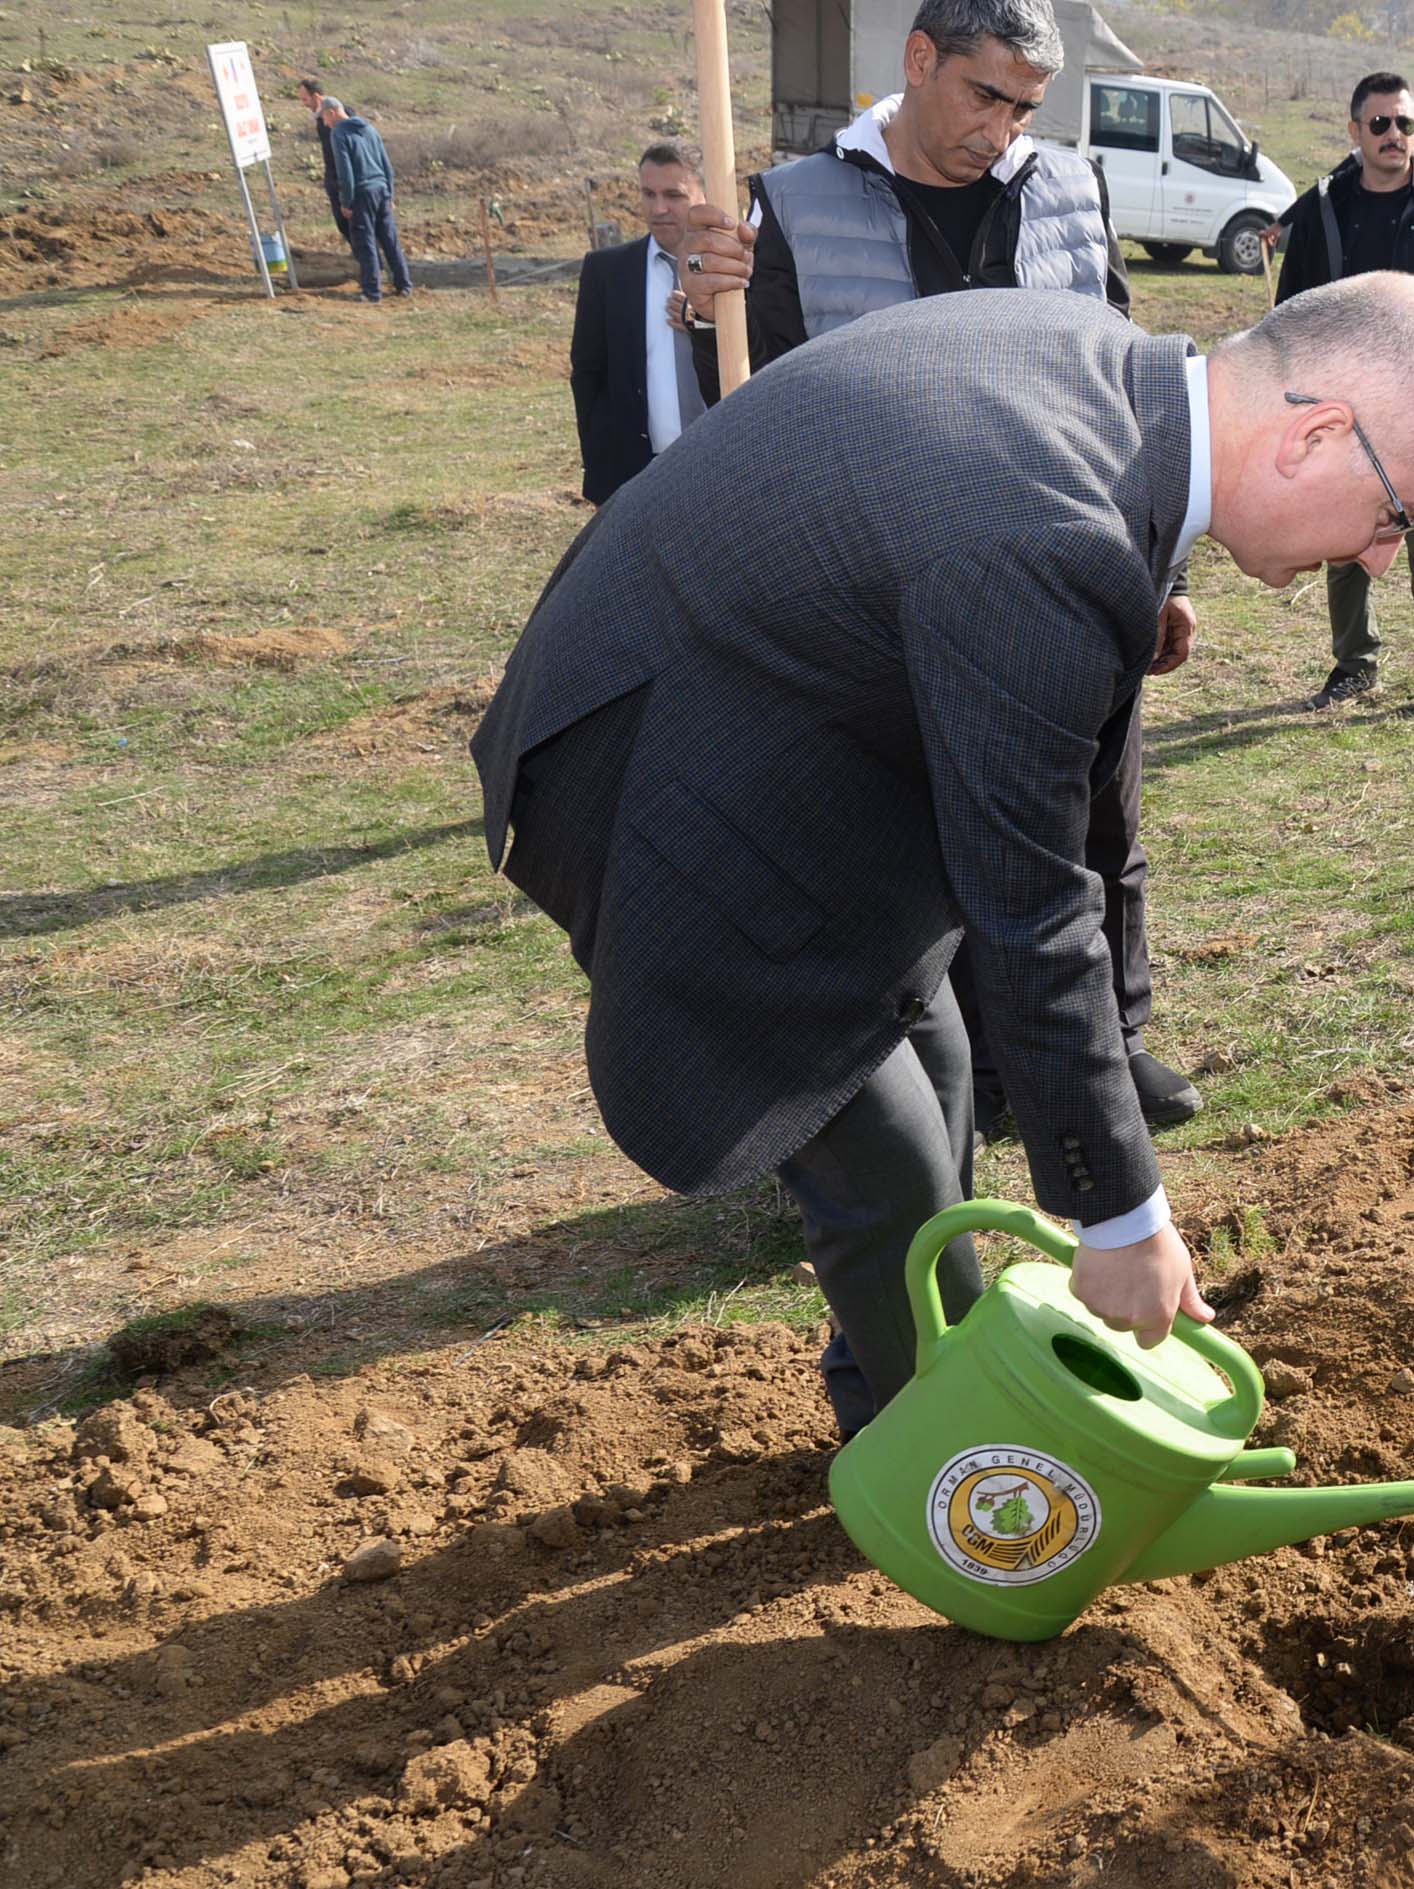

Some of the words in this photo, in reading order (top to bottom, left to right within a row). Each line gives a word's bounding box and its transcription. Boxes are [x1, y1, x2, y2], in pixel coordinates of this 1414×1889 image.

[938, 1460, 978, 1509] ORMAN
[991, 1455, 1055, 1479] GENEL
[962, 1524, 994, 1555] OGM
[962, 1559, 988, 1575] 1839
